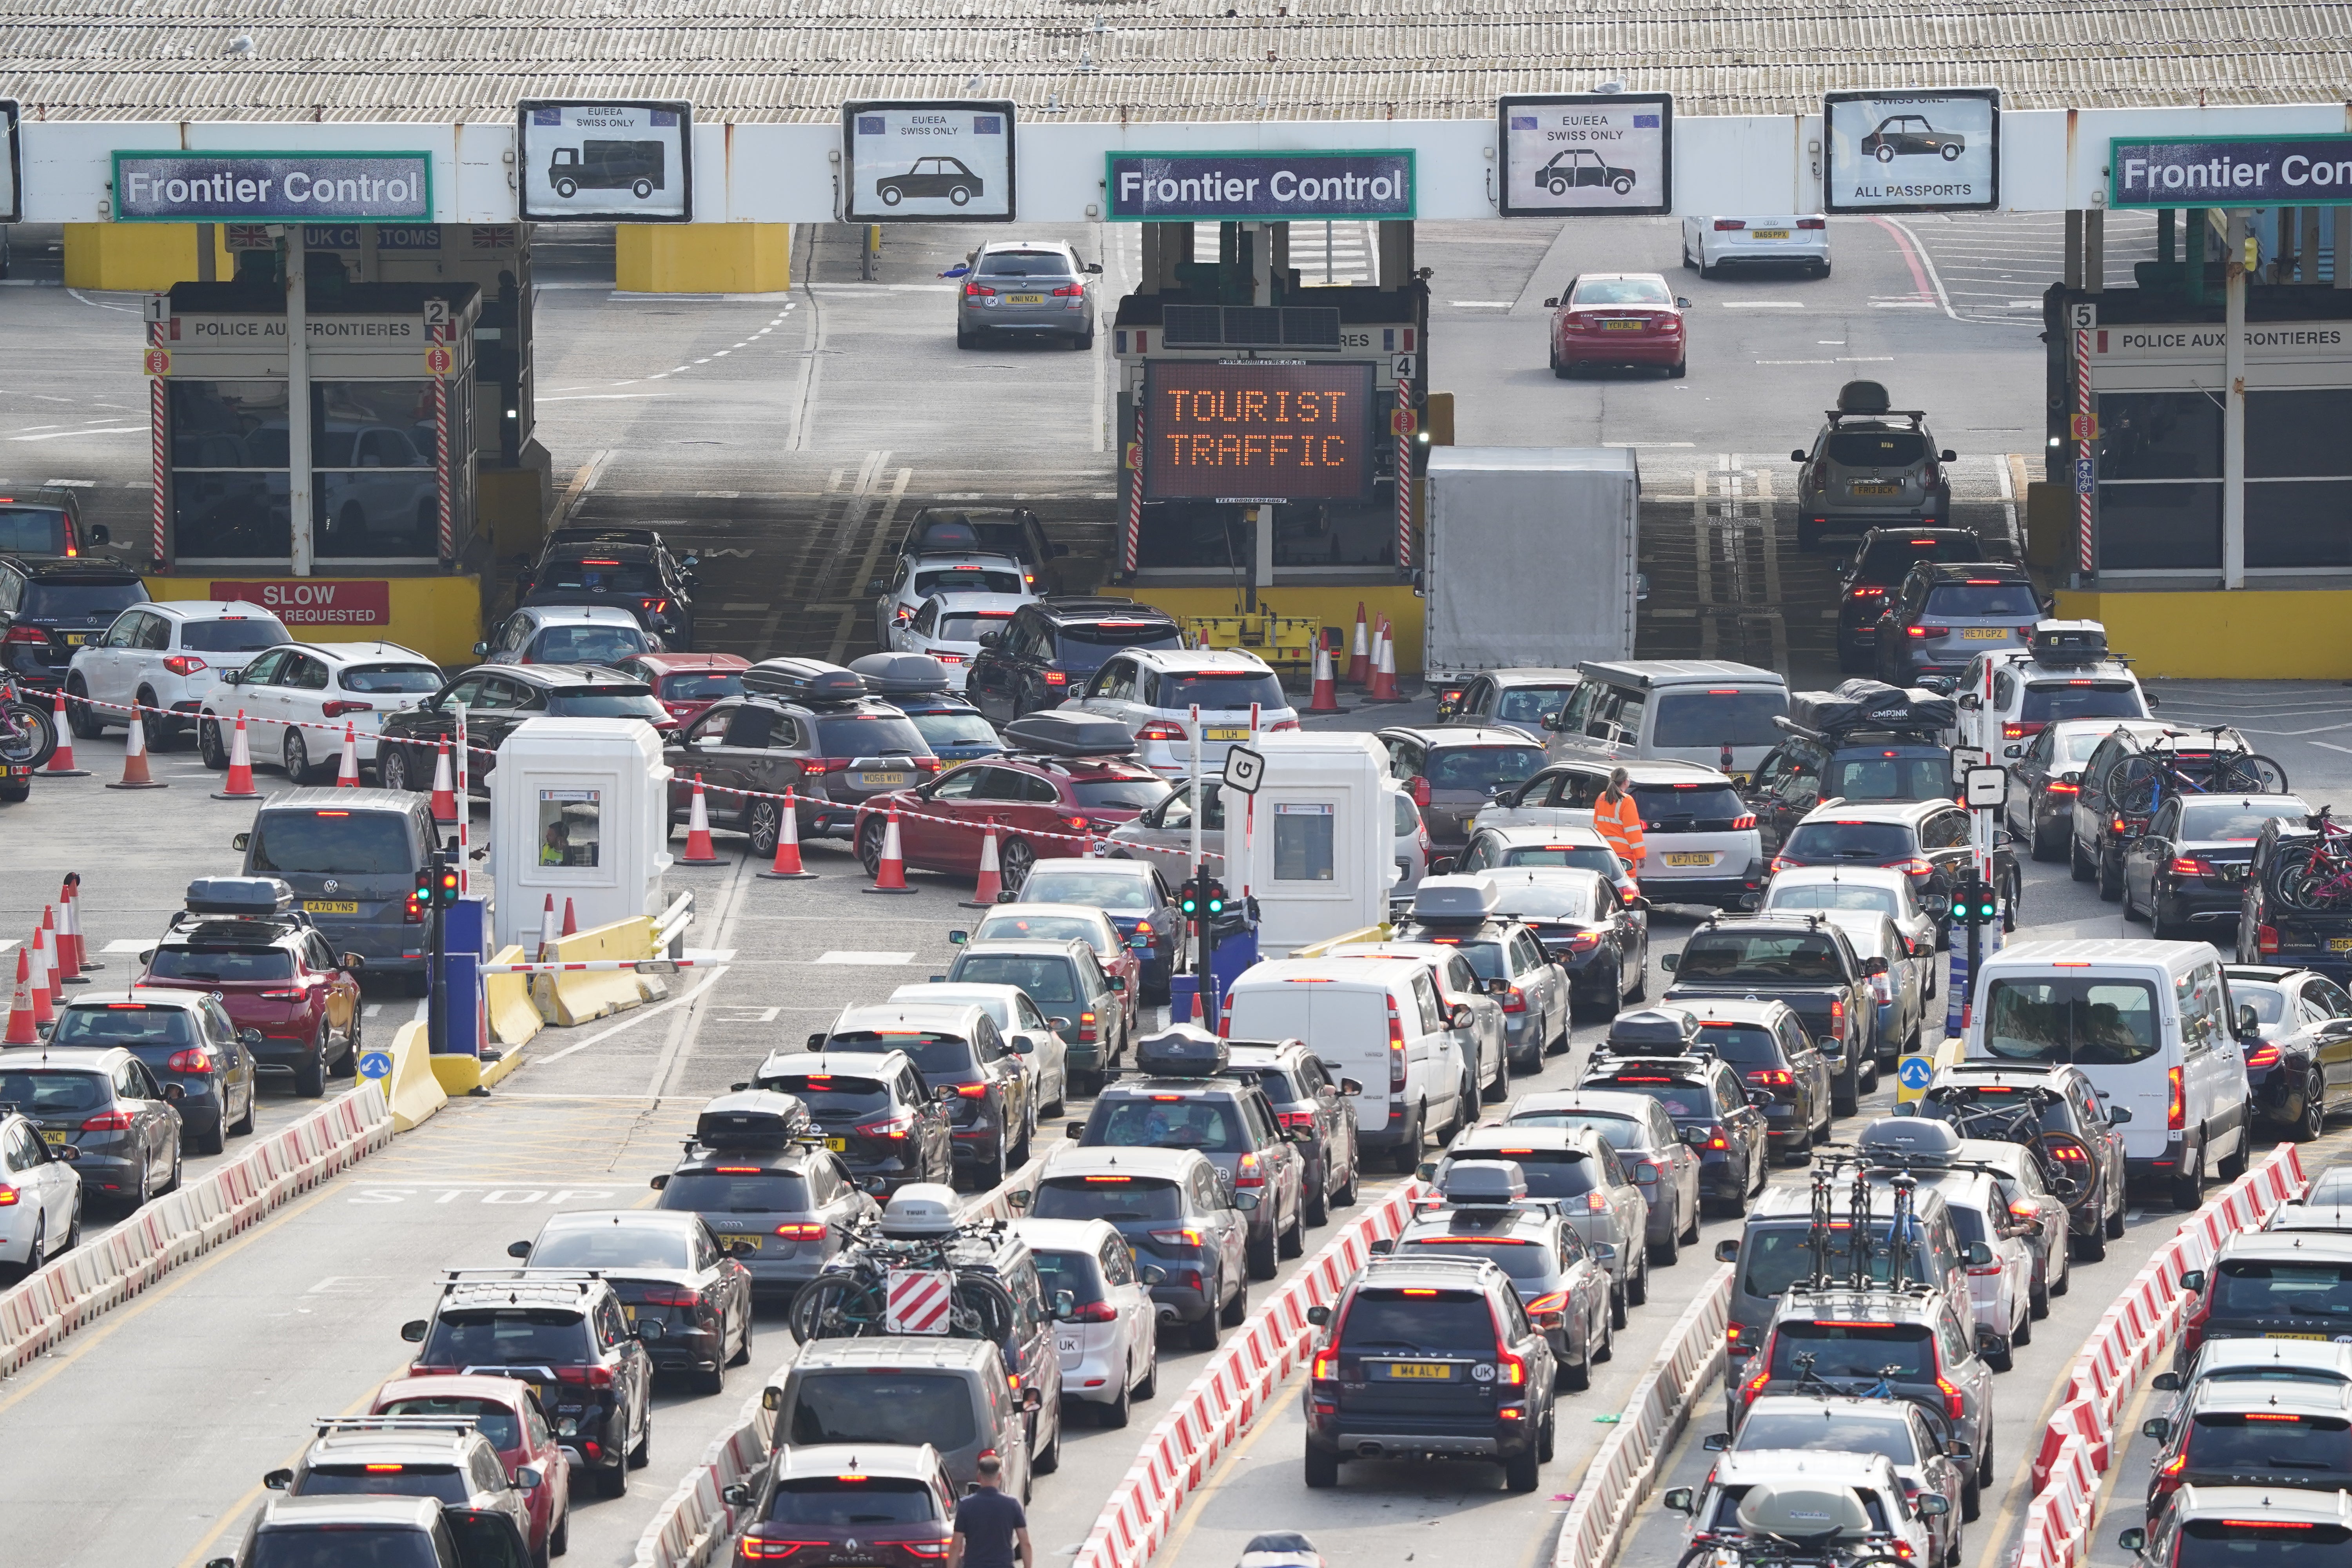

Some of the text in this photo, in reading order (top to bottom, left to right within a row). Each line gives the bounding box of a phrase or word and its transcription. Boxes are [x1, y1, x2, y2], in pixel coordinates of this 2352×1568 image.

[577, 118, 635, 127] SWISS ONLY
[912, 116, 946, 125] EU/EEA
[1563, 116, 1608, 125] EU/EEA
[932, 127, 958, 135] ONLY
[1547, 130, 1623, 141] SWISS ONLY
[2125, 156, 2270, 189] Frontier
[129, 172, 417, 203] Frontier Control
[1121, 170, 1401, 201] Frontier Control
[1855, 184, 1971, 198] ALL PASSPORTS
[306, 229, 334, 245] UK
[152, 299, 161, 319] 1
[430, 303, 443, 323] 2
[2077, 306, 2091, 326] 5
[196, 323, 258, 334] POLICE
[263, 323, 287, 334] AU
[2123, 331, 2341, 348] POLICE AUX RONTIERES
[153, 352, 162, 372] STOP
[1397, 358, 1410, 376] 4
[1168, 390, 1345, 421] TOURIST
[1167, 435, 1344, 466] TRAFFIC
[264, 586, 336, 604] SLOW
[285, 610, 376, 622] REQUESTED
[1965, 630, 2002, 639] RE71 GPZ
[1236, 761, 1252, 778] G
[307, 902, 354, 911] CA70 YNS
[348, 1189, 615, 1204] STOP
[1060, 1340, 1075, 1351] UK
[1419, 1366, 1440, 1375] ALY
[1476, 1367, 1491, 1377] UK
